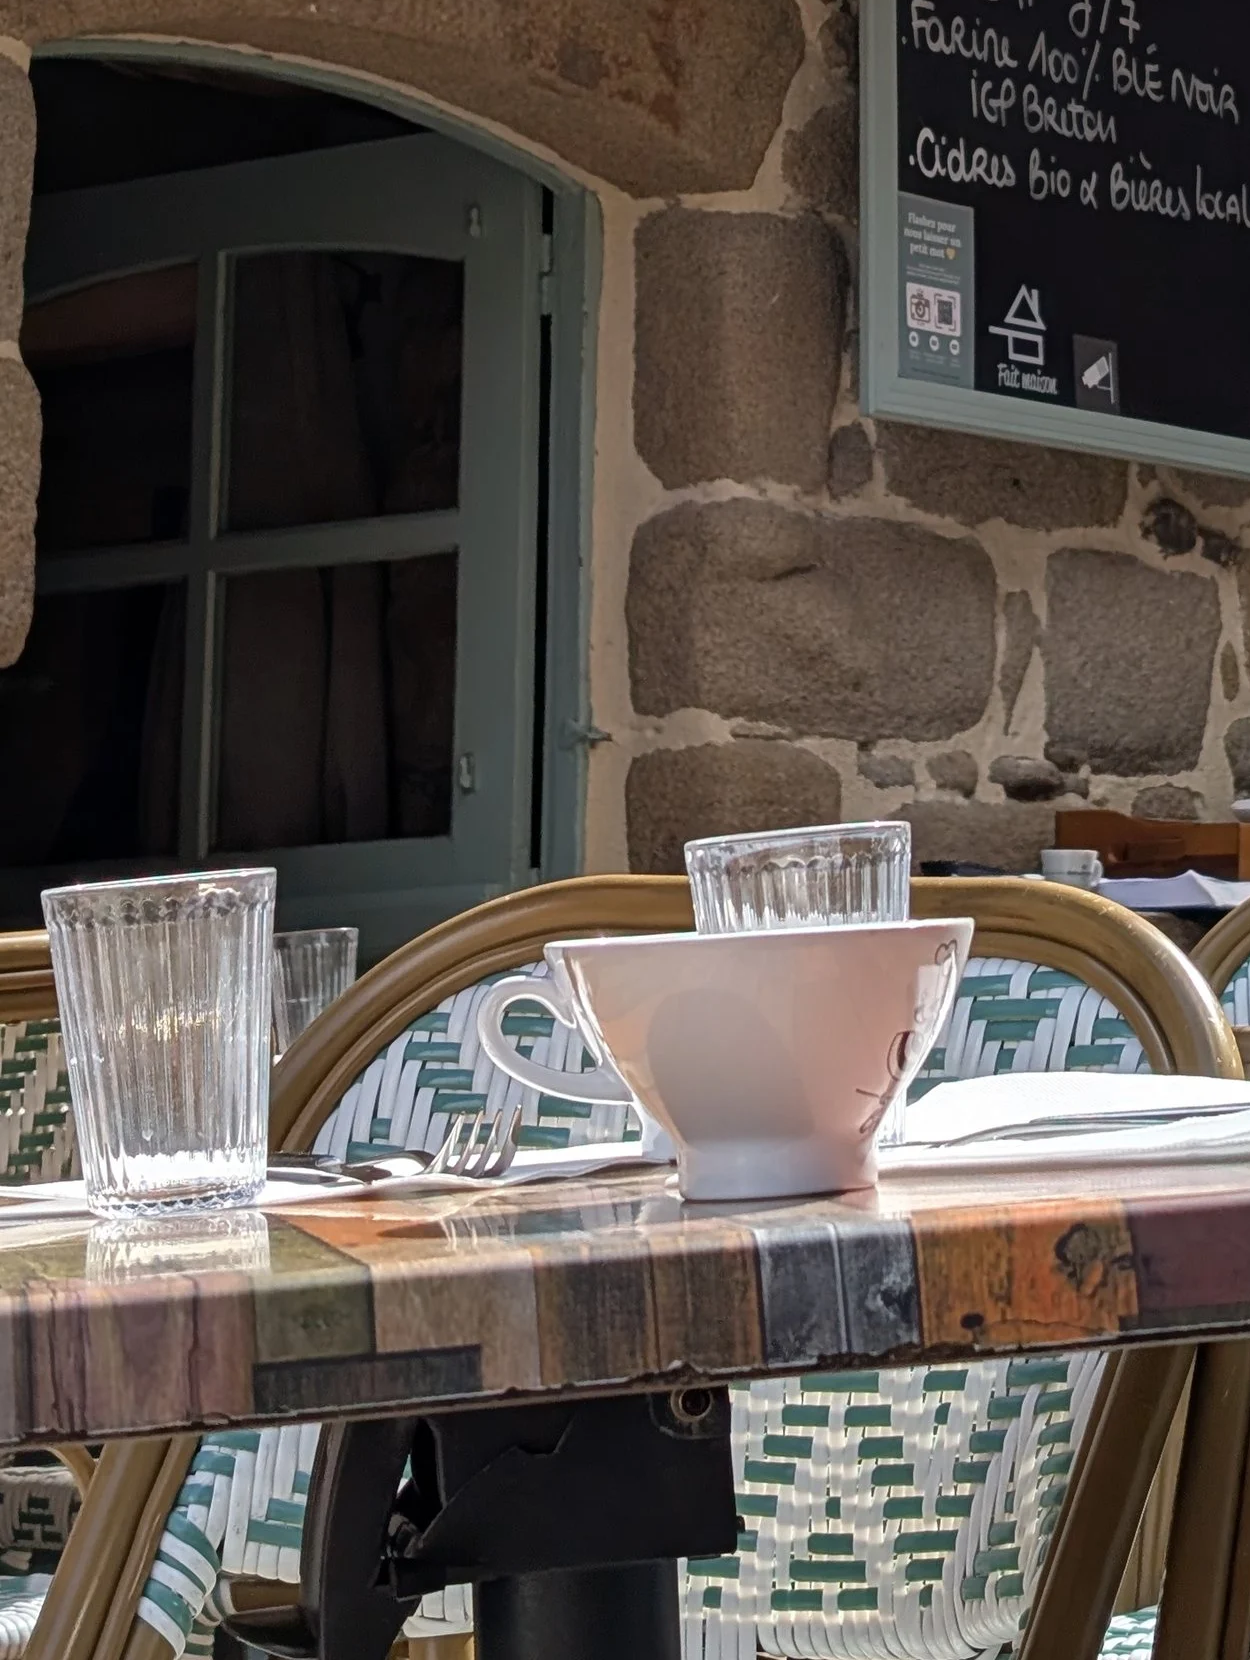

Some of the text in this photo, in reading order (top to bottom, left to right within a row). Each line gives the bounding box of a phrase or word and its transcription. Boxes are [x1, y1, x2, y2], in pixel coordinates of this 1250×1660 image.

[1028, 30, 1101, 101] 100%
[996, 362, 1058, 395] Fait maison
